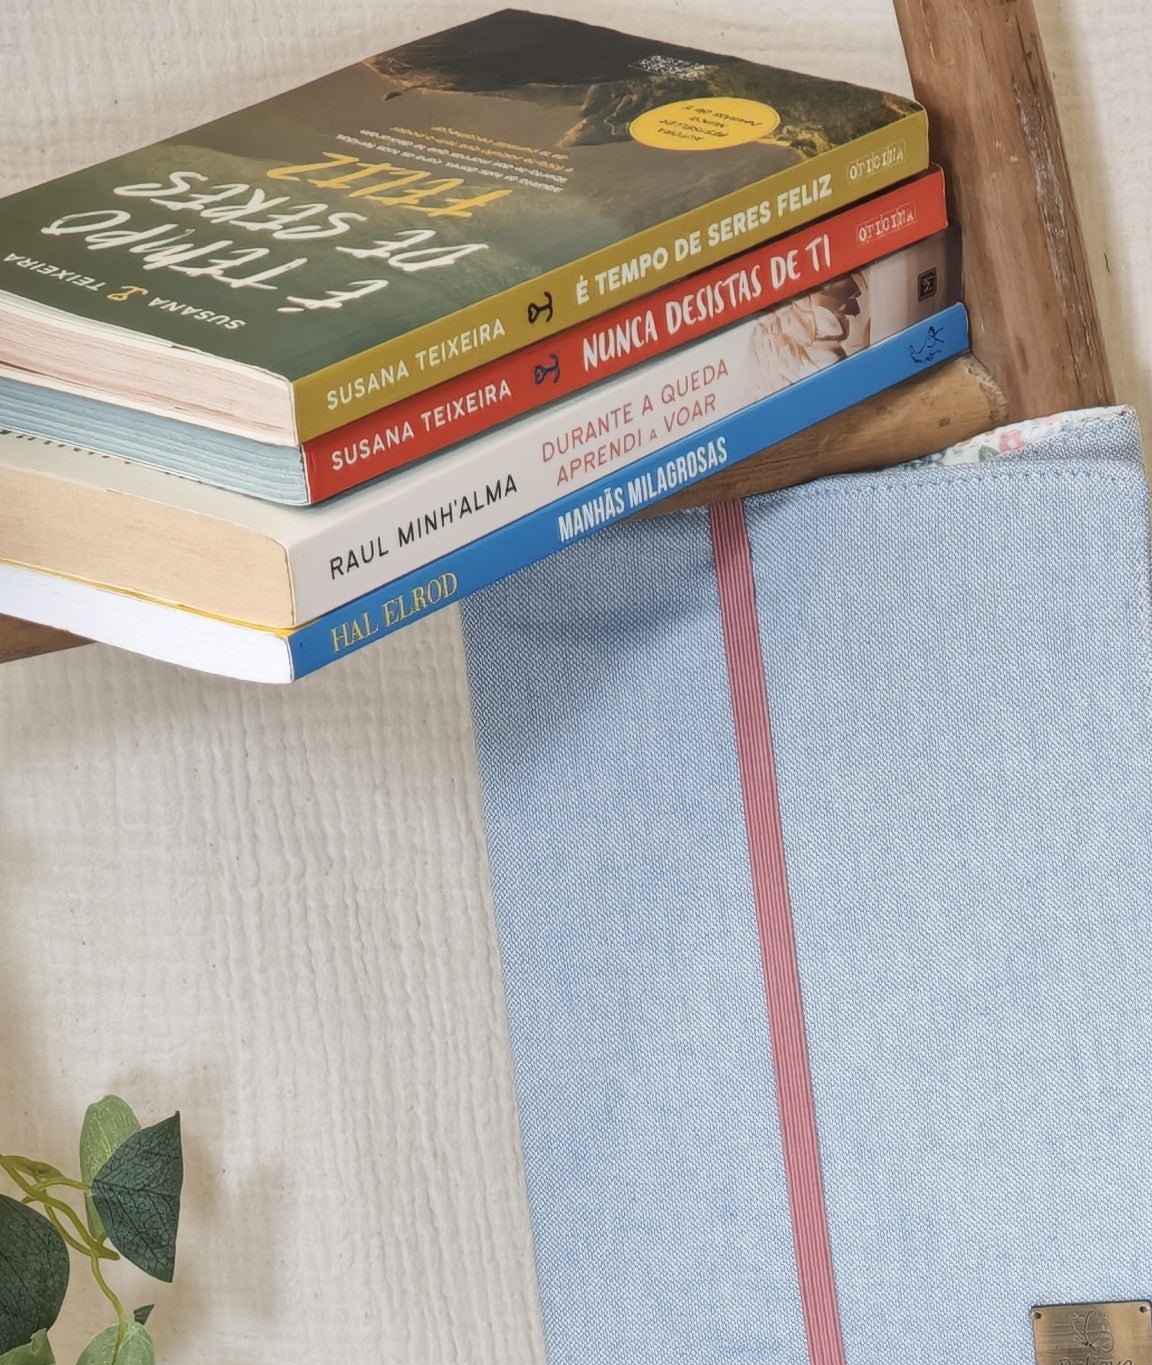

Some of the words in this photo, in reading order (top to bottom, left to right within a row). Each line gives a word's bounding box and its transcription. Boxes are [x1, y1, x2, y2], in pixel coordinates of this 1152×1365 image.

[114, 170, 367, 239] SERES
[266, 151, 513, 218] FELIZ
[3, 252, 106, 291] TEIXEIRA
[41, 209, 308, 290] TEMPO
[326, 360, 409, 410] SUSANA
[415, 318, 506, 371] TEIXEIRA
[576, 274, 590, 304] É
[594, 247, 669, 296] TEMPO
[674, 230, 702, 262] DE
[708, 201, 772, 247] SERES
[777, 173, 832, 216] FELIZ
[335, 230, 489, 271] DE
[147, 297, 248, 330] SUSANA
[332, 421, 415, 471] SUSANA
[420, 379, 512, 432] TEIXEIRA
[582, 310, 658, 372] NUNCA
[665, 264, 762, 335] DESISTAS
[770, 249, 802, 290] DE
[805, 233, 832, 273] TI
[542, 401, 634, 464] DURANTE
[642, 397, 655, 413] A
[660, 358, 729, 402] QUEDA
[556, 433, 643, 486] APRENDI
[664, 392, 717, 433] VOAR
[329, 536, 389, 580] RAUL
[399, 473, 518, 548] MINH'ALMA
[331, 611, 379, 653] HAL
[382, 572, 459, 627] ELROD
[558, 490, 626, 541] MANHÃS
[628, 436, 728, 509] MILAGROSAS
